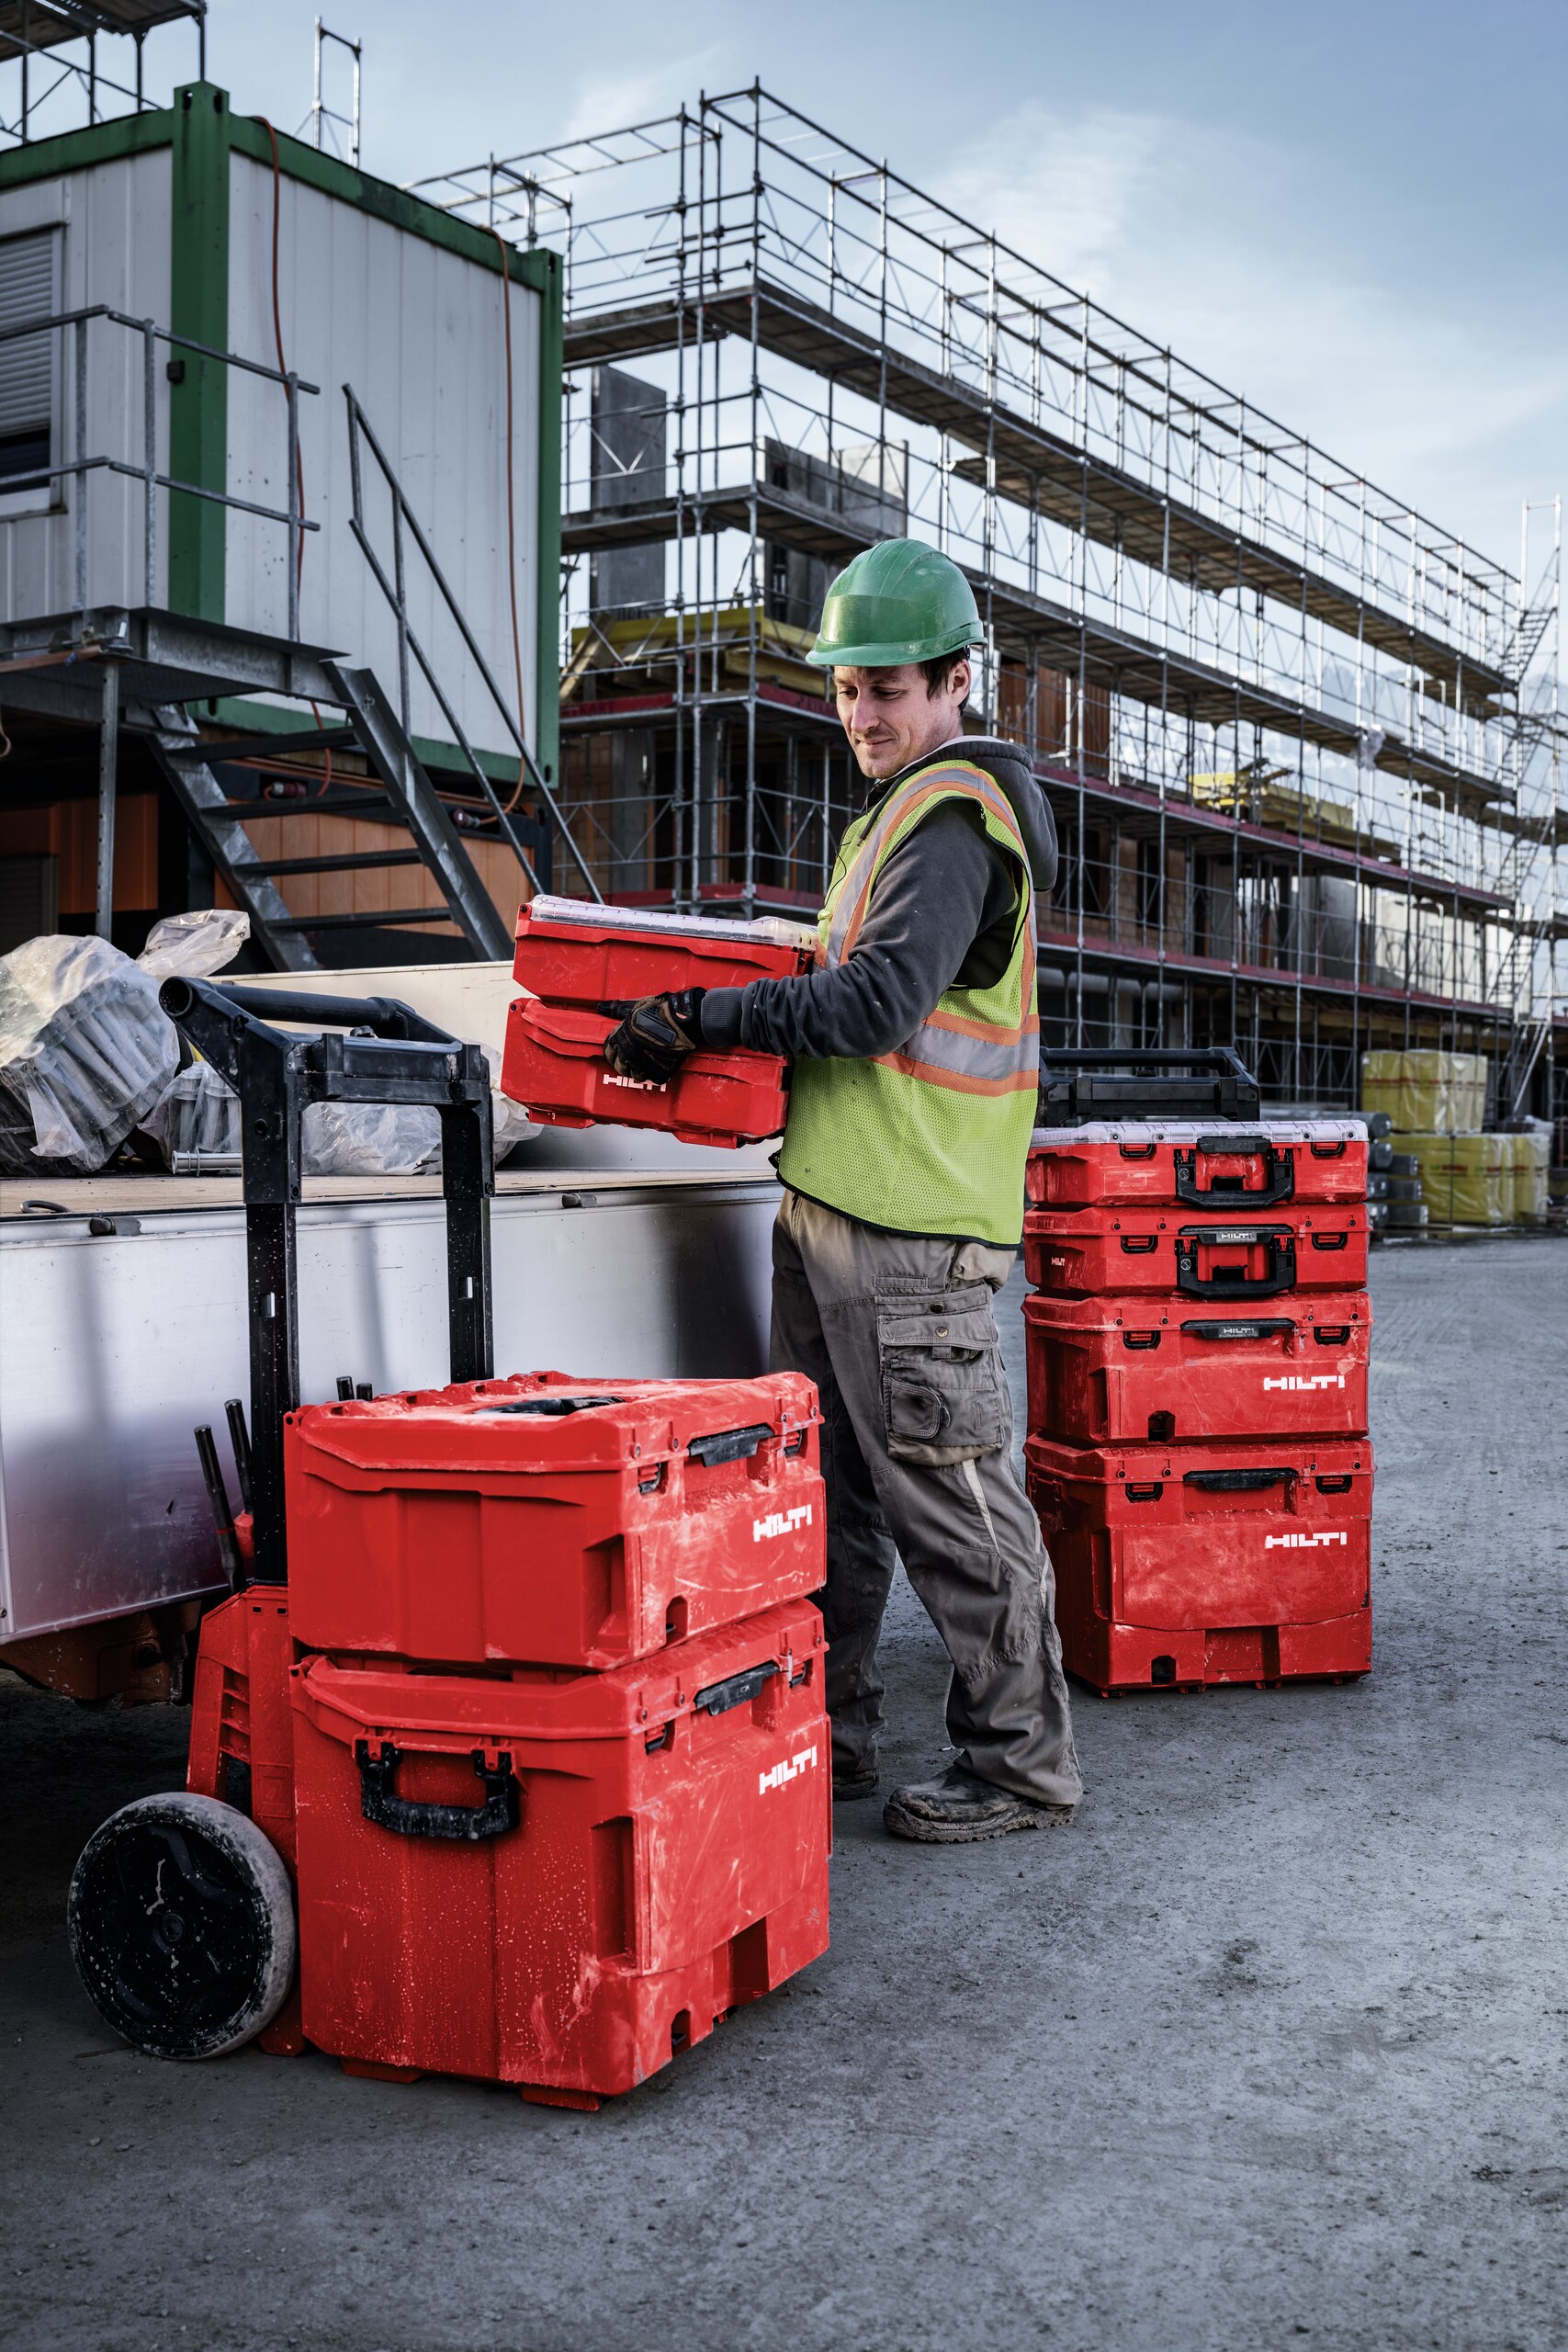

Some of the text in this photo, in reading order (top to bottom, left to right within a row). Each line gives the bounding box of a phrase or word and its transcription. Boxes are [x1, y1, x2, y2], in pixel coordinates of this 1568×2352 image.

[603, 1073, 667, 1092] HILTI
[1051, 1257, 1066, 1266] HILT
[1263, 1374, 1346, 1391] HILTI
[752, 1504, 813, 1543] HILTI
[1265, 1532, 1348, 1549] HILTI
[759, 1746, 818, 1795] HILTI
